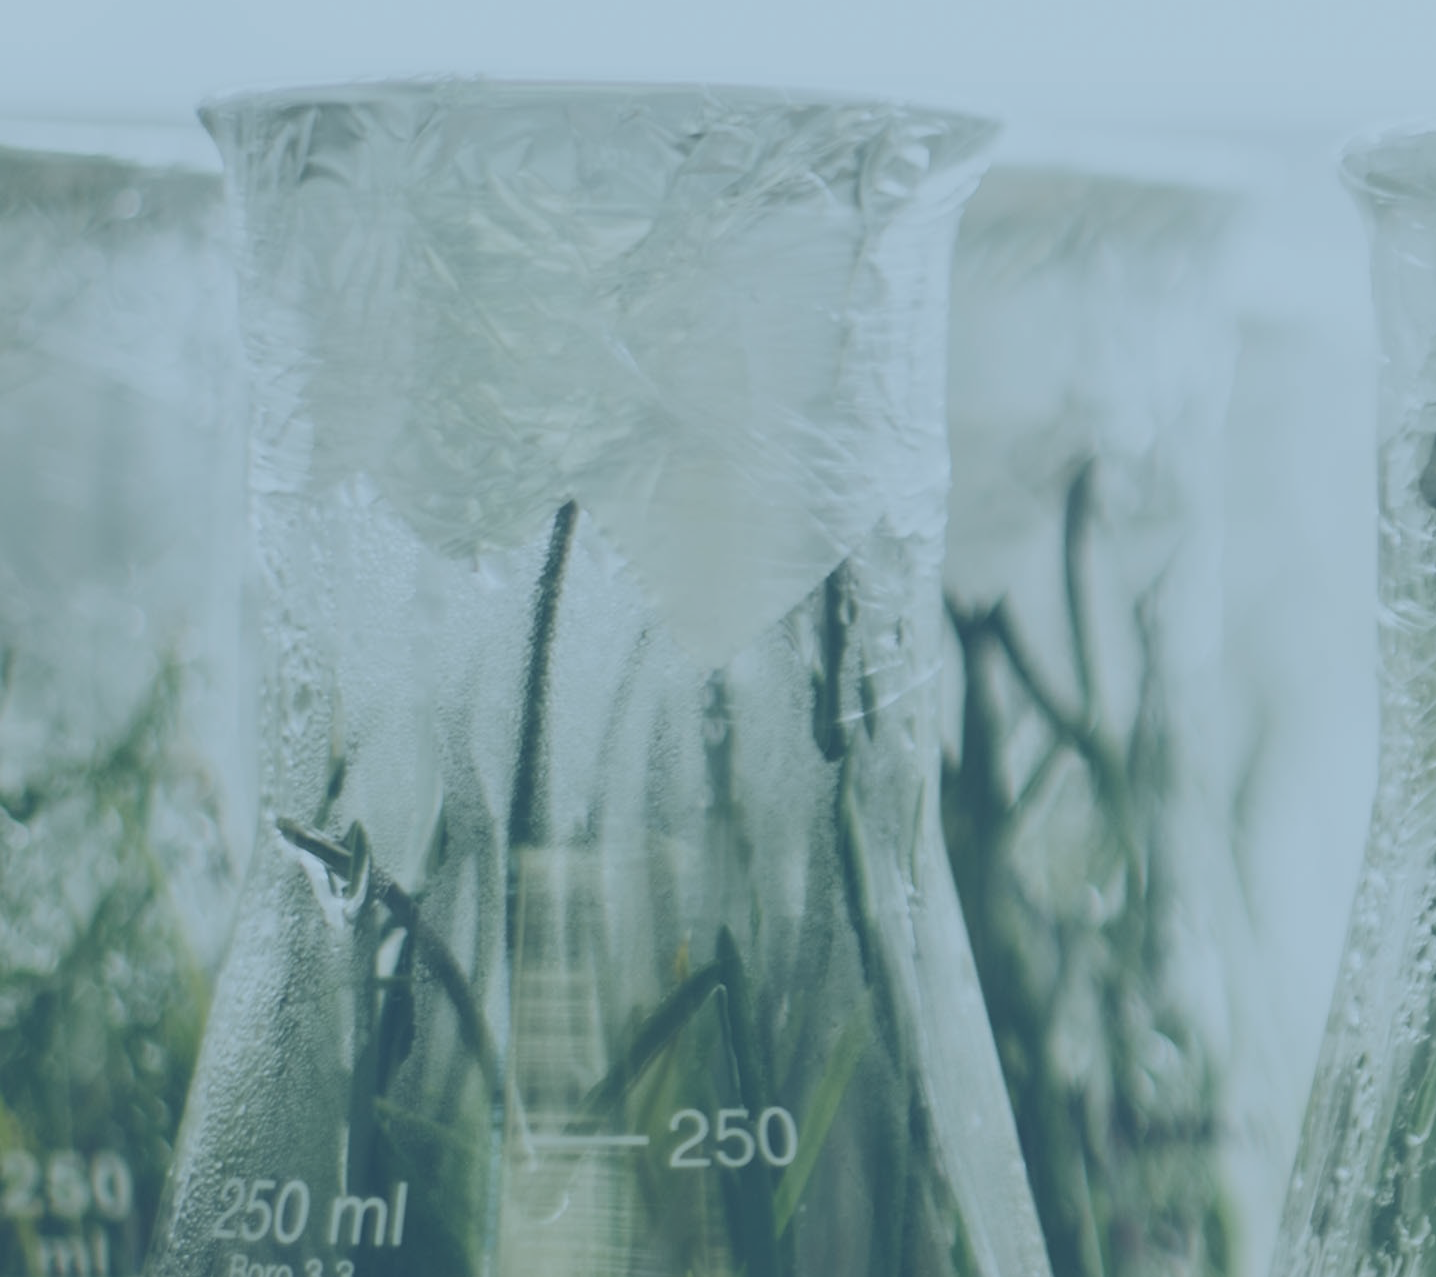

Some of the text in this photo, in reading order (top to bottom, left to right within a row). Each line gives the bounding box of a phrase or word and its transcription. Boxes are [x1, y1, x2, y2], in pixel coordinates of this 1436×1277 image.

[668, 1105, 799, 1170] 250
[213, 1178, 408, 1247] 250 ml
